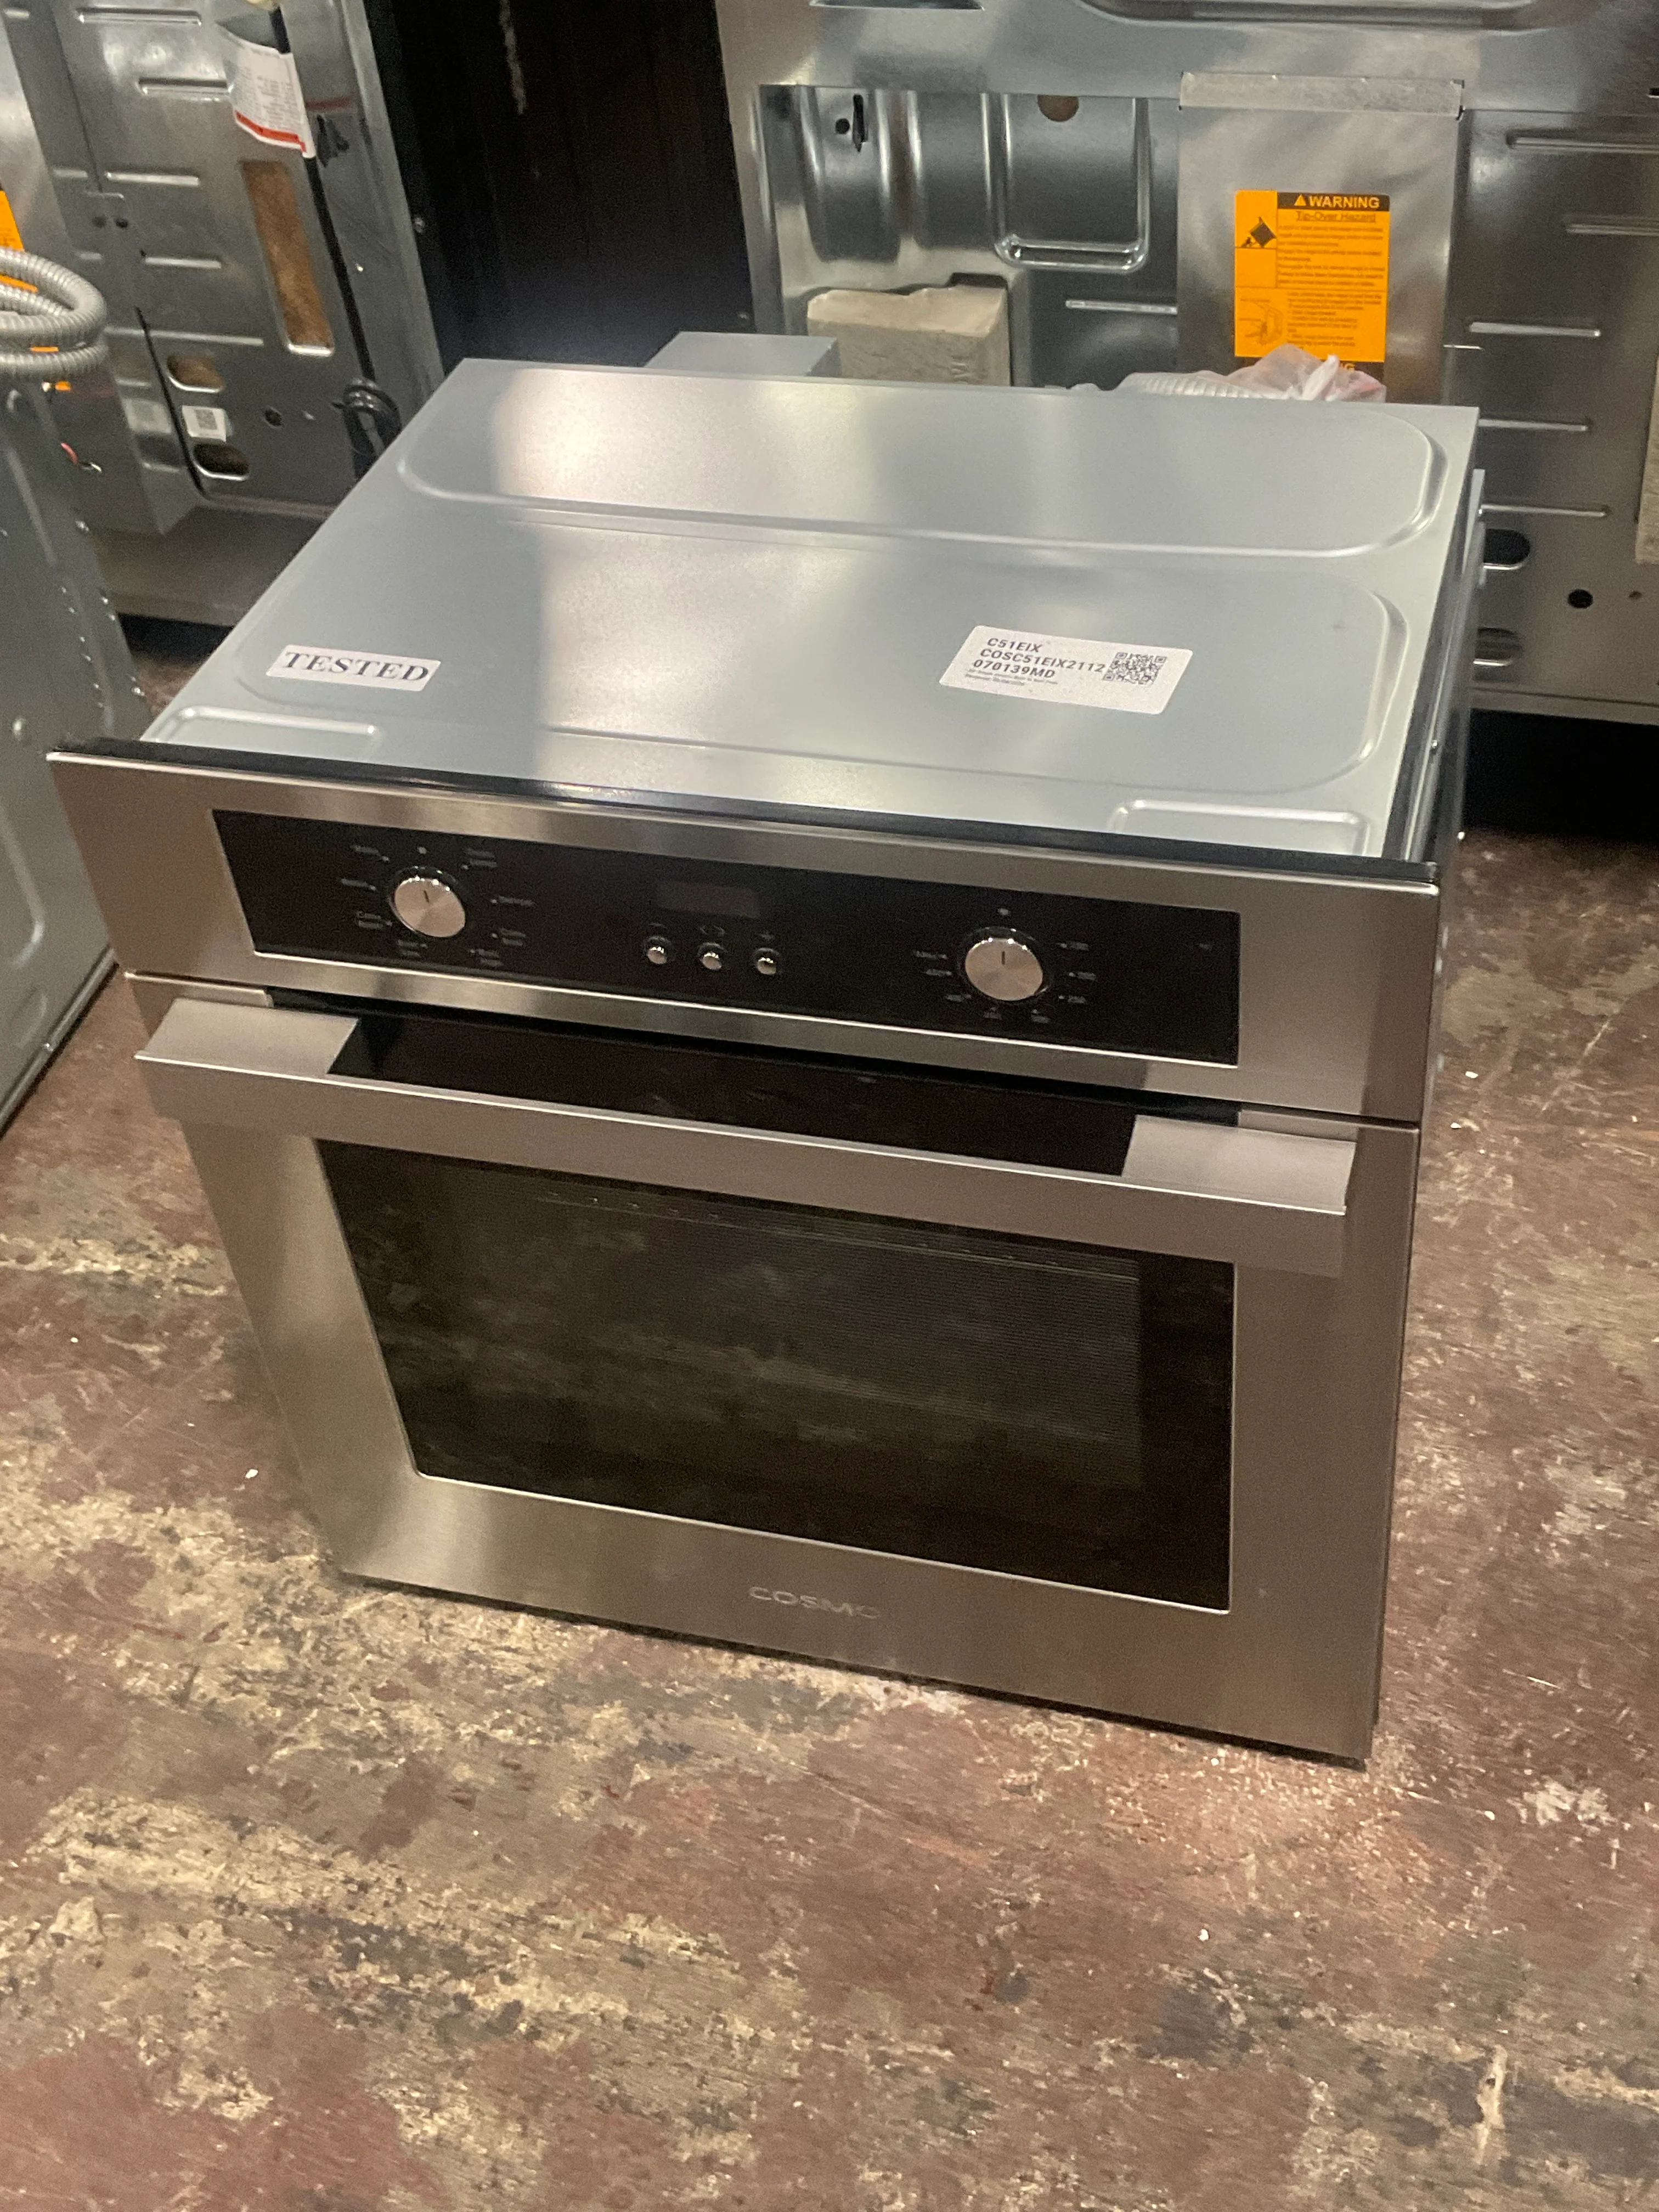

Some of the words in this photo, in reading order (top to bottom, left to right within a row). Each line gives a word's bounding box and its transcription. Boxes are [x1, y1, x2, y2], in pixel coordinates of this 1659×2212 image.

[1308, 195, 1380, 208] WARNING
[986, 637, 1043, 653] C51EIX
[284, 651, 430, 681] TESTED
[973, 658, 1056, 679] 070139MD
[979, 648, 1106, 673] COSC51EIX2112
